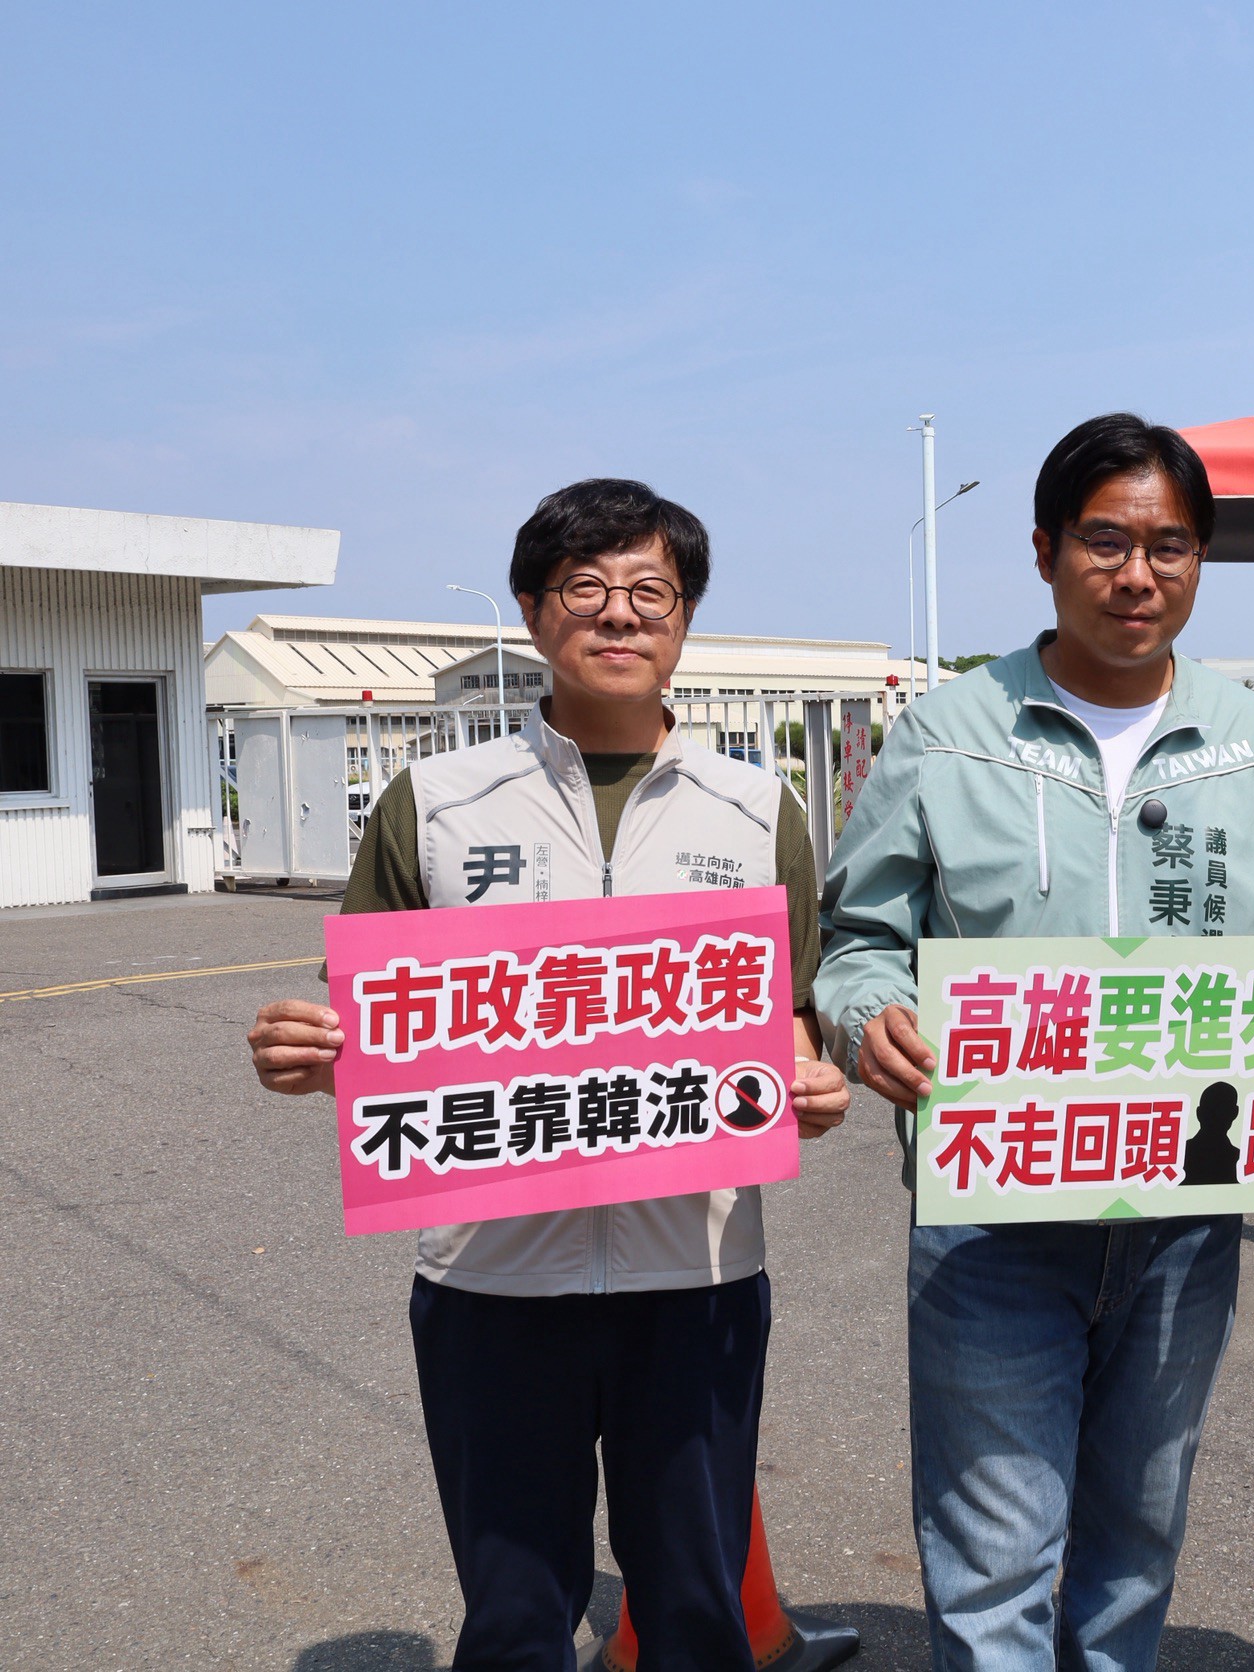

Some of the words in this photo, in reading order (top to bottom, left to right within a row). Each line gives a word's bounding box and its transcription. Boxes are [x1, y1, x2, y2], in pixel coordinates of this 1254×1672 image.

[1007, 736, 1082, 779] TEAM
[1152, 739, 1254, 780] TAIWAN
[463, 844, 527, 904] 尹
[689, 869, 745, 889] 高雄向前
[1149, 822, 1195, 936] 蔡秉
[362, 940, 768, 1054] 市政靠政策
[361, 1066, 711, 1171] 不是靠韓流
